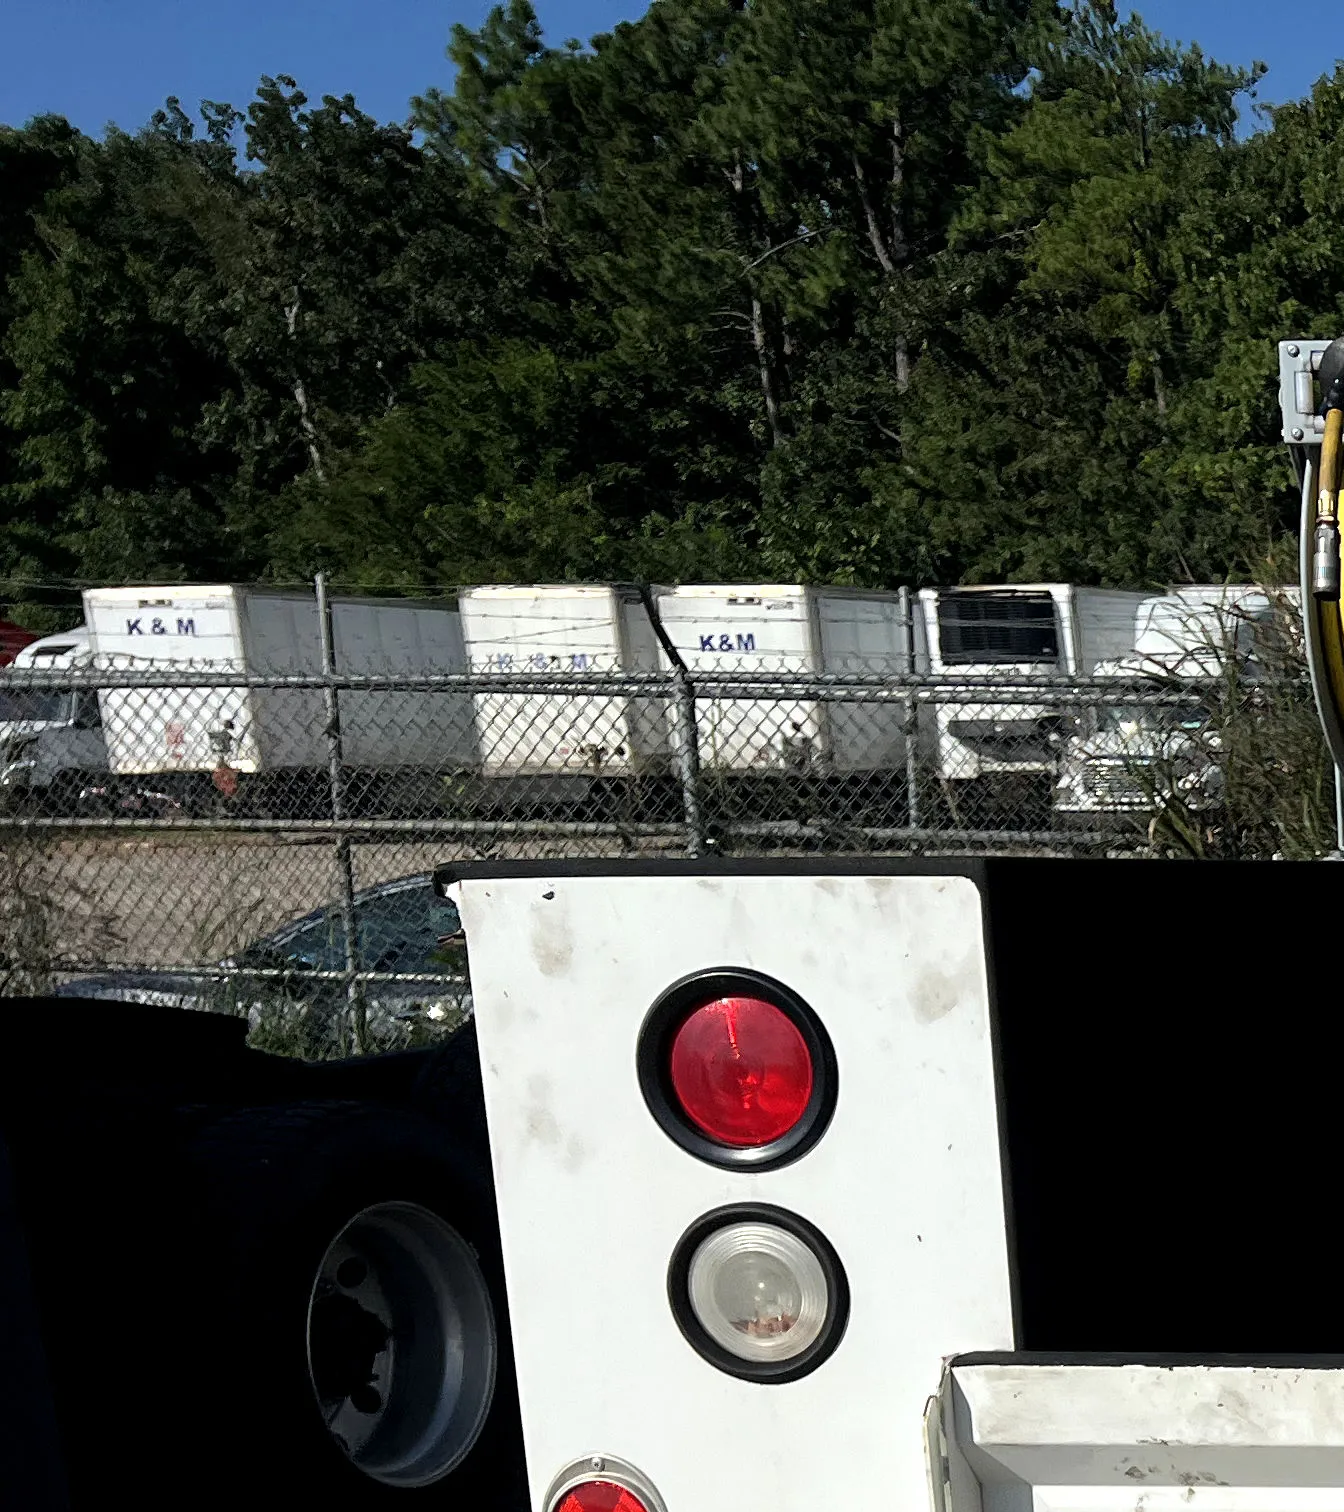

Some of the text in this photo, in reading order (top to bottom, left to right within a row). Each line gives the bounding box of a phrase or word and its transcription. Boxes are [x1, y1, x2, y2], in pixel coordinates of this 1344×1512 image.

[126, 617, 196, 635] K & M
